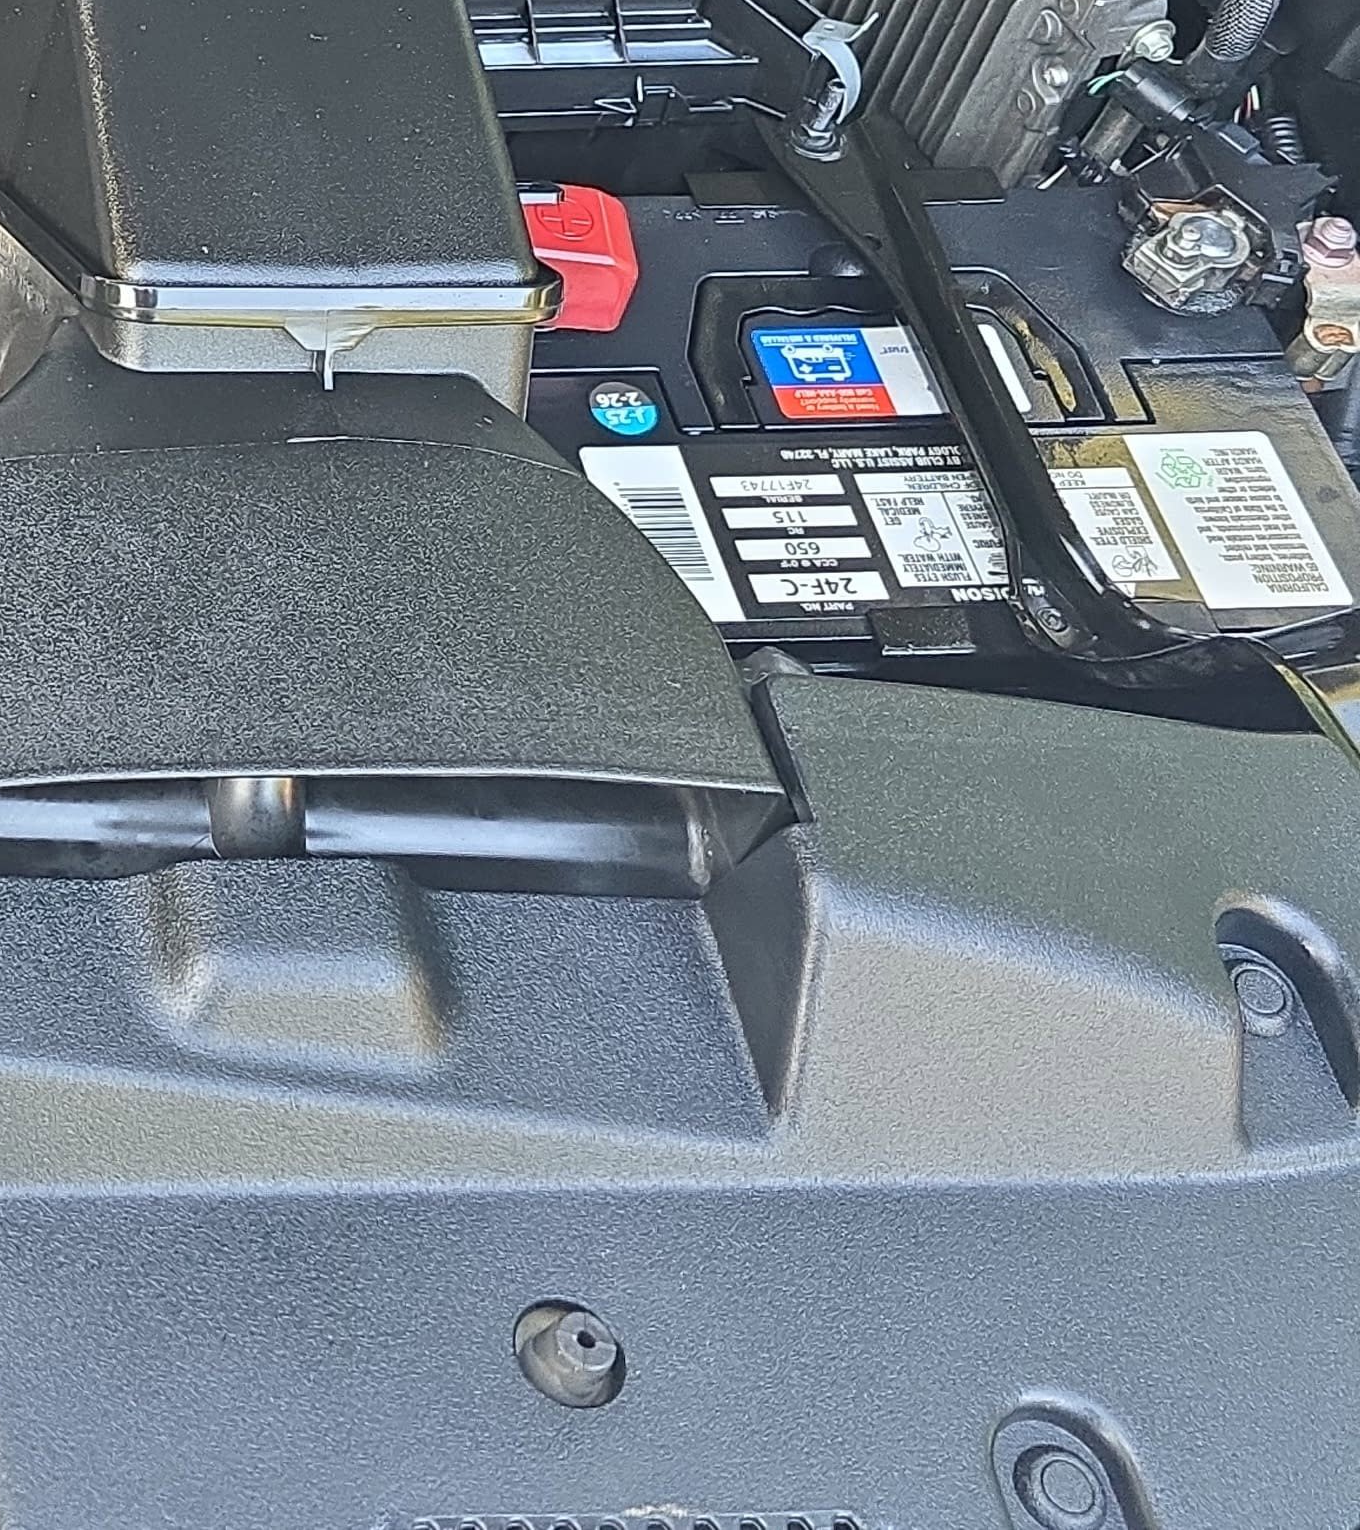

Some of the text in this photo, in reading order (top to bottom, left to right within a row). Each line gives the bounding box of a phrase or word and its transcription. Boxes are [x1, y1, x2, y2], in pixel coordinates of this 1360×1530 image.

[772, 511, 808, 524] 115
[784, 542, 821, 556] 650
[1251, 572, 1325, 583] PROPOSITION
[780, 577, 858, 597] 24F-C
[1266, 582, 1330, 593] CALIFORNIA
